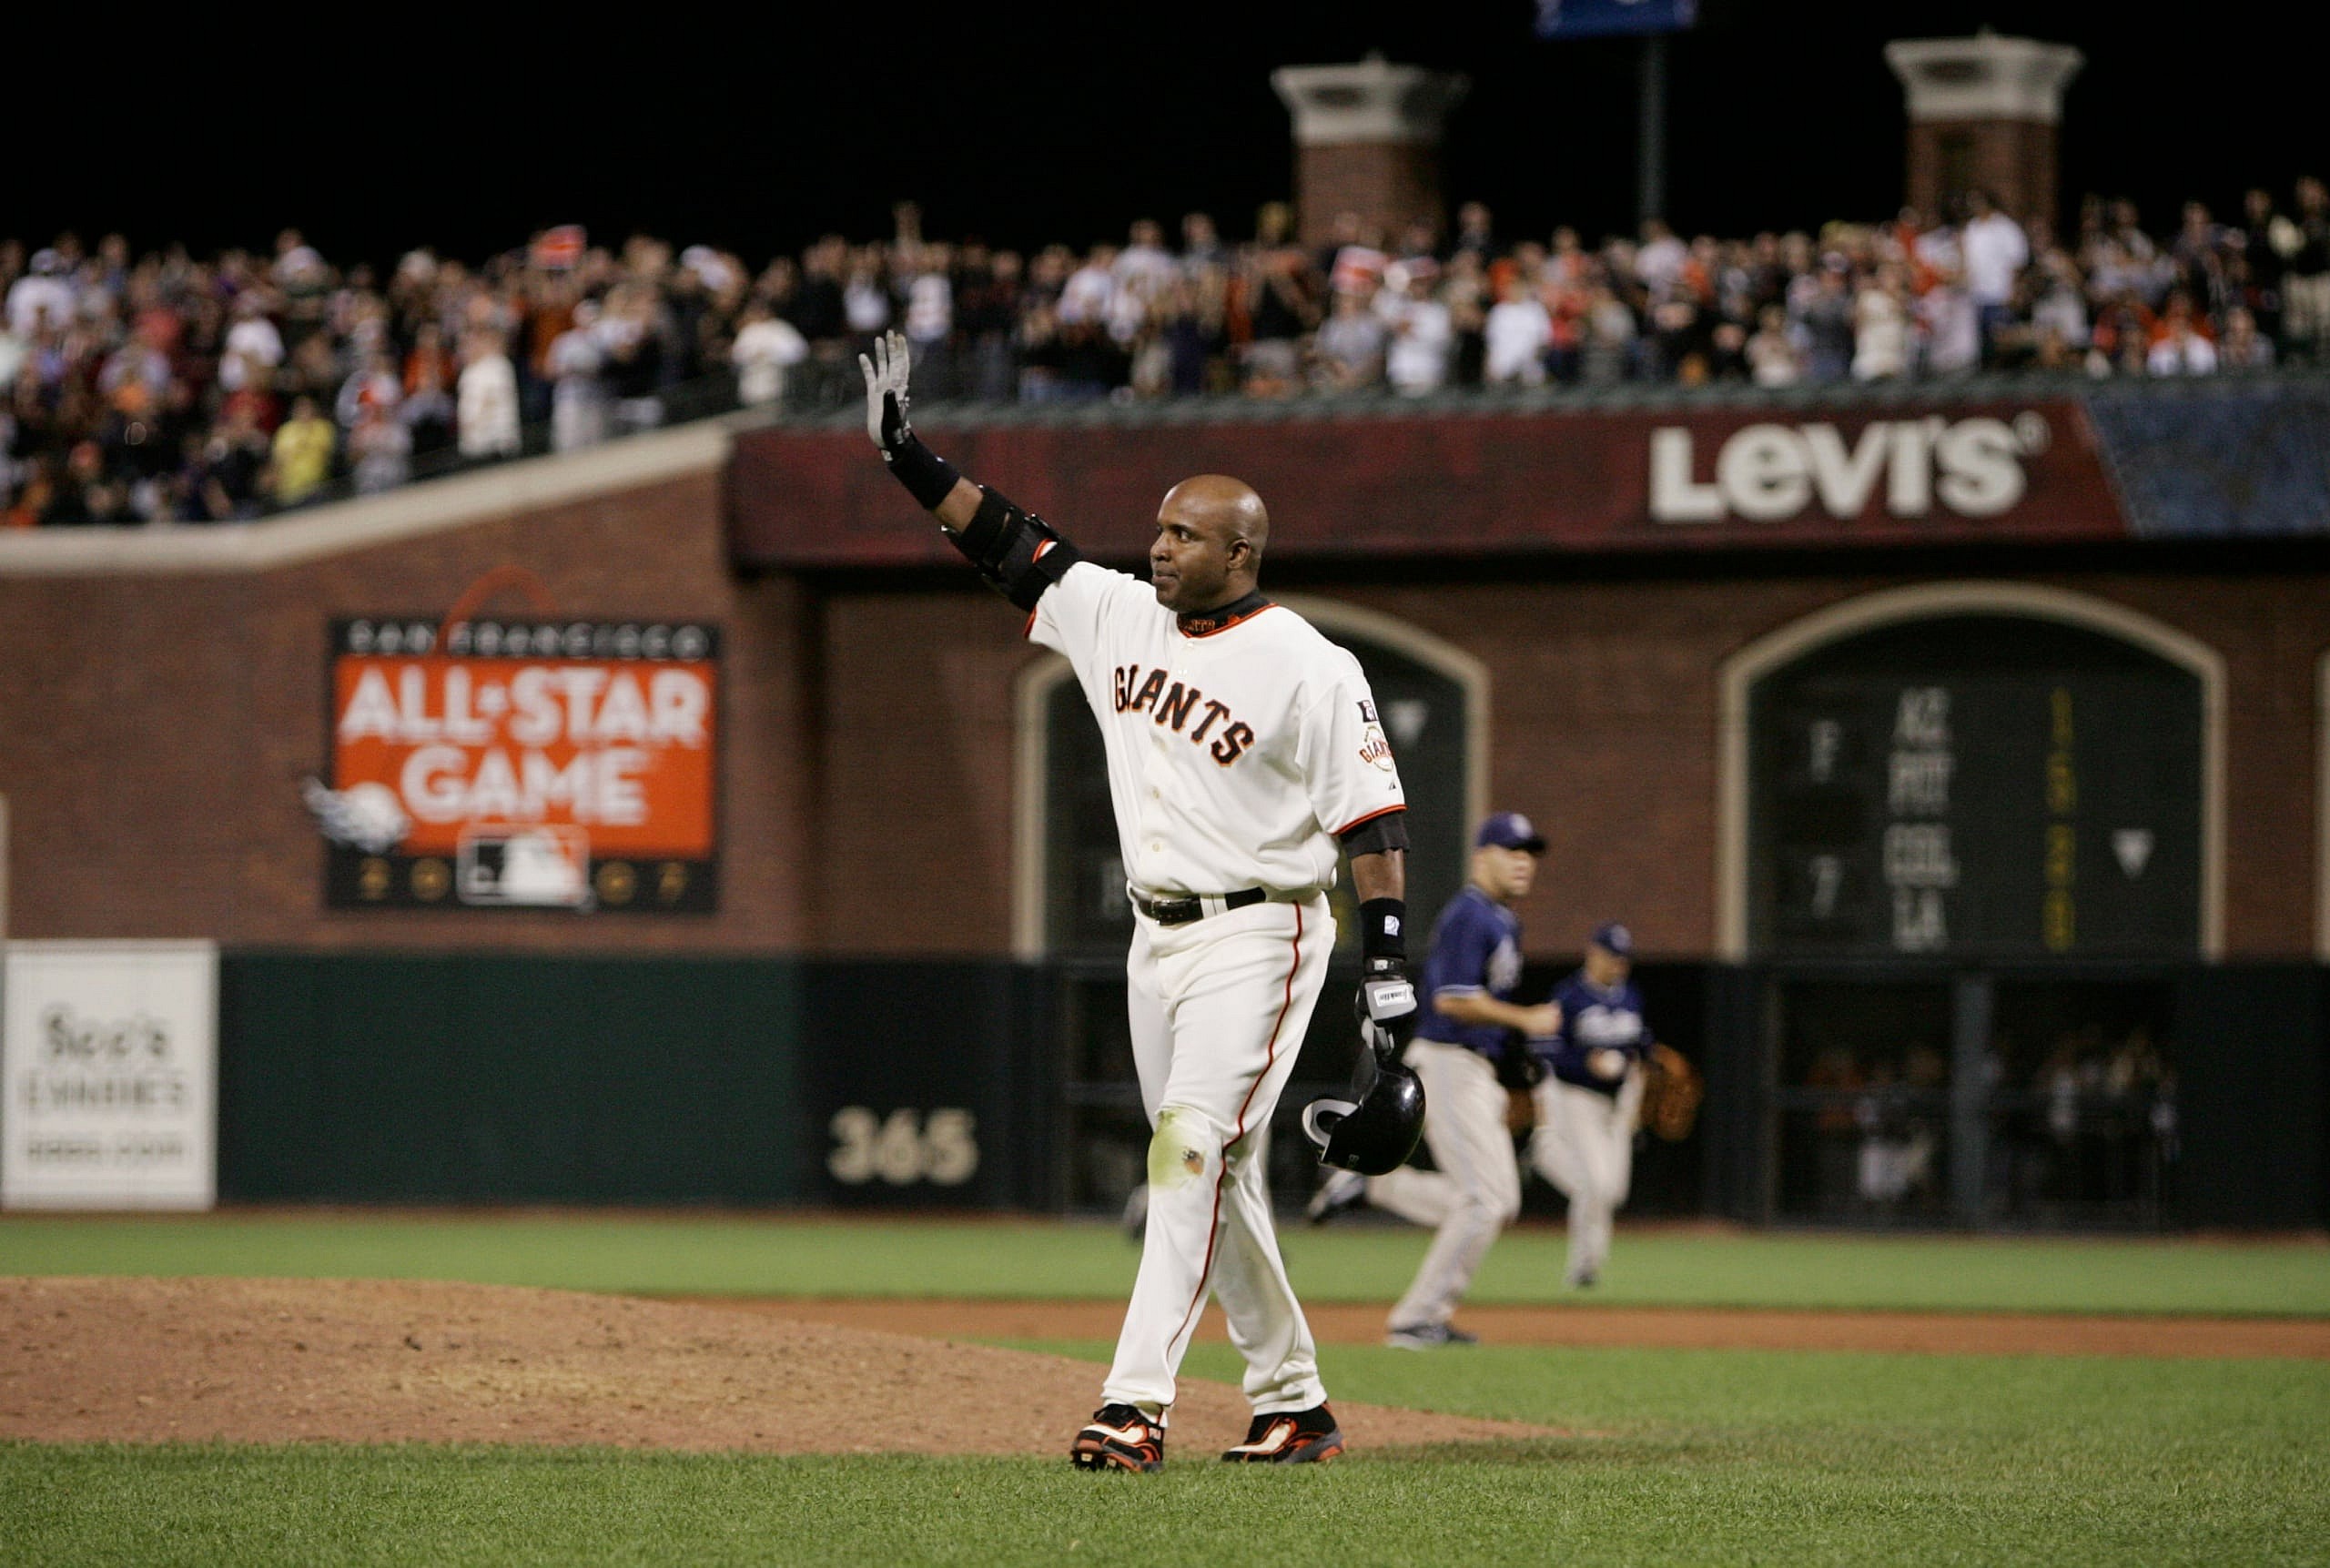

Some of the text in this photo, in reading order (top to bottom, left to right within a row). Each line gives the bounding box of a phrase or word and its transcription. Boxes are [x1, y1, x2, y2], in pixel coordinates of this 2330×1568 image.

[1114, 663, 1255, 767] GIANTS
[400, 744, 646, 824] GAME
[828, 1105, 979, 1185] 365
